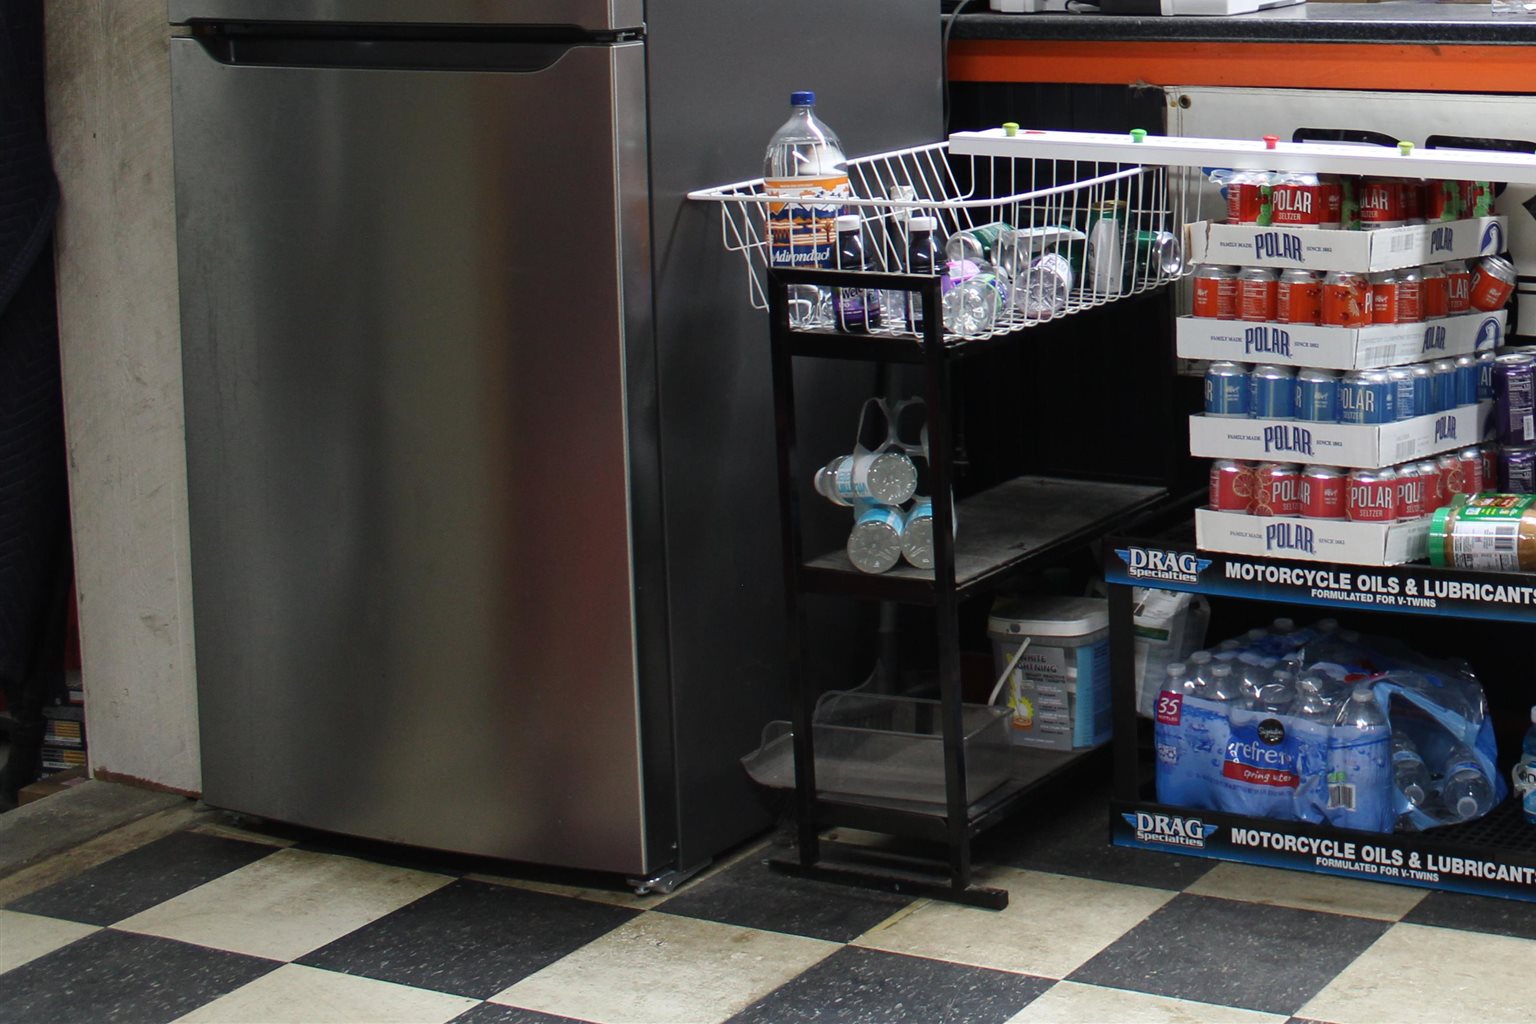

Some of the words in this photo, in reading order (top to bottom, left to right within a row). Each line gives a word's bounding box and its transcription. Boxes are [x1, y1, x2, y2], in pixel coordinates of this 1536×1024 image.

[1272, 189, 1311, 214] POLAR
[1255, 232, 1303, 261] POLAR
[1430, 227, 1454, 254] POLAR
[1450, 278, 1468, 299] LAR
[1245, 326, 1290, 357] POLAR
[1342, 387, 1375, 412] OLAR
[1264, 425, 1312, 456] POLAR
[1435, 415, 1457, 444] POLAR
[1351, 486, 1392, 509] POLAR
[1360, 509, 1383, 517] SELTZER
[1266, 523, 1314, 554] POLAR
[1129, 548, 1198, 574] DRAG
[1130, 567, 1197, 582] Specialties
[1225, 562, 1351, 589] MOTORCYCLE
[1357, 575, 1400, 594] OILS
[1405, 578, 1419, 596] &
[1311, 589, 1373, 603] FORMULATED
[1376, 594, 1395, 605] FOR
[1397, 596, 1437, 608] V-TWINS
[1159, 697, 1179, 715] 35
[1136, 813, 1204, 839] DRAG
[1137, 830, 1204, 847] Specialties
[1231, 828, 1355, 859] MOTORCYCLE
[1361, 845, 1403, 866] OILS
[1408, 852, 1422, 869] &
[1316, 857, 1377, 873] FORMULATED
[1380, 866, 1399, 877] FOR
[1401, 869, 1439, 882] V-TWINS
